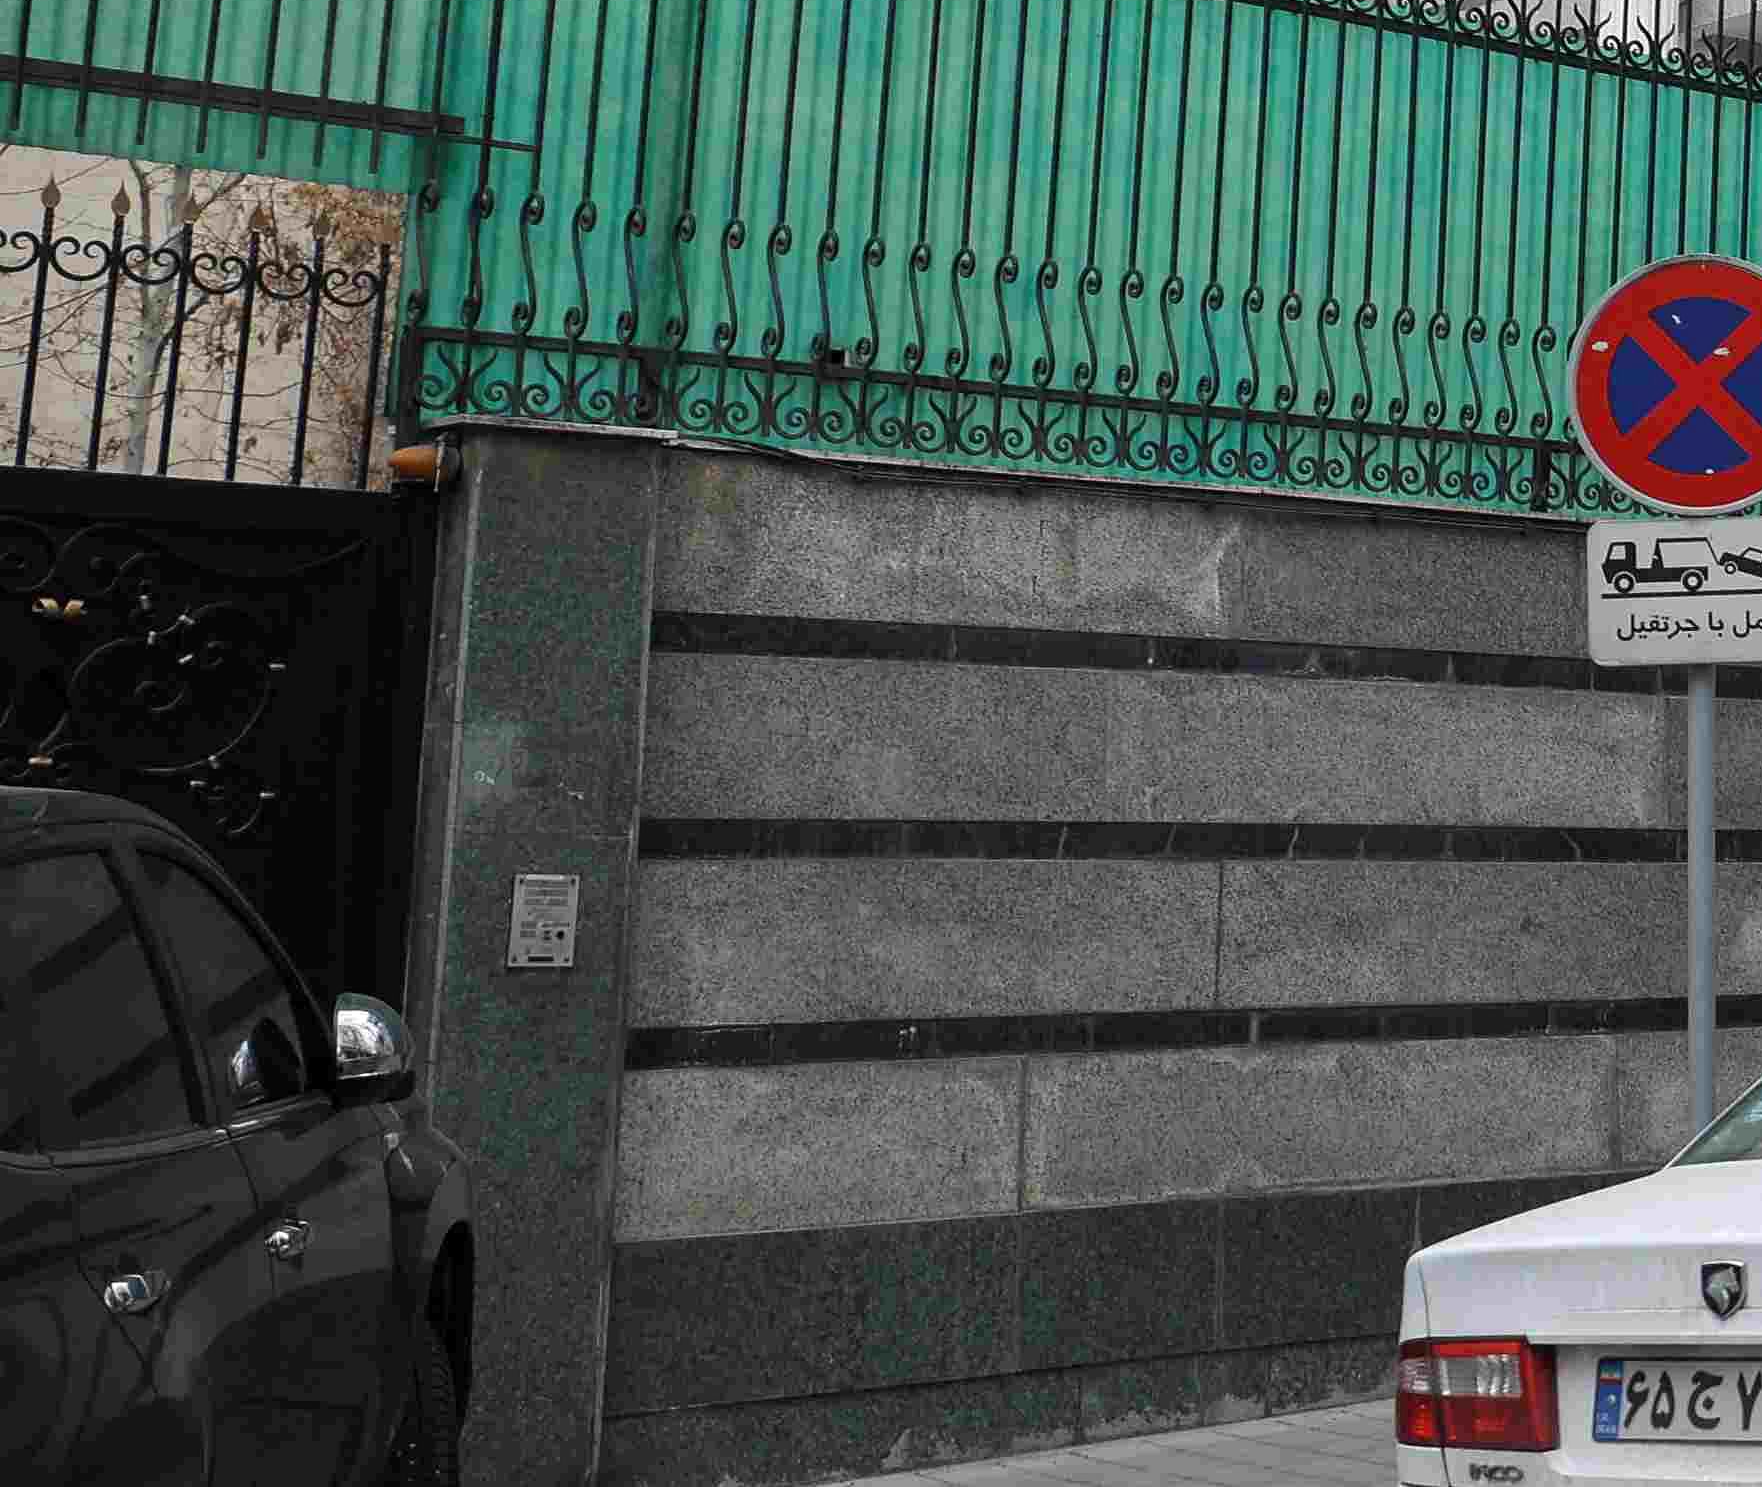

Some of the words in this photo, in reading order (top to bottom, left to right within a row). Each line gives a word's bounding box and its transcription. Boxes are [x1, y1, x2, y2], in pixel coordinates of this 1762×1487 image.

[1707, 611, 1725, 638] با
[1623, 1369, 1677, 1430] ۶۵
[1687, 1370, 1725, 1430] ج
